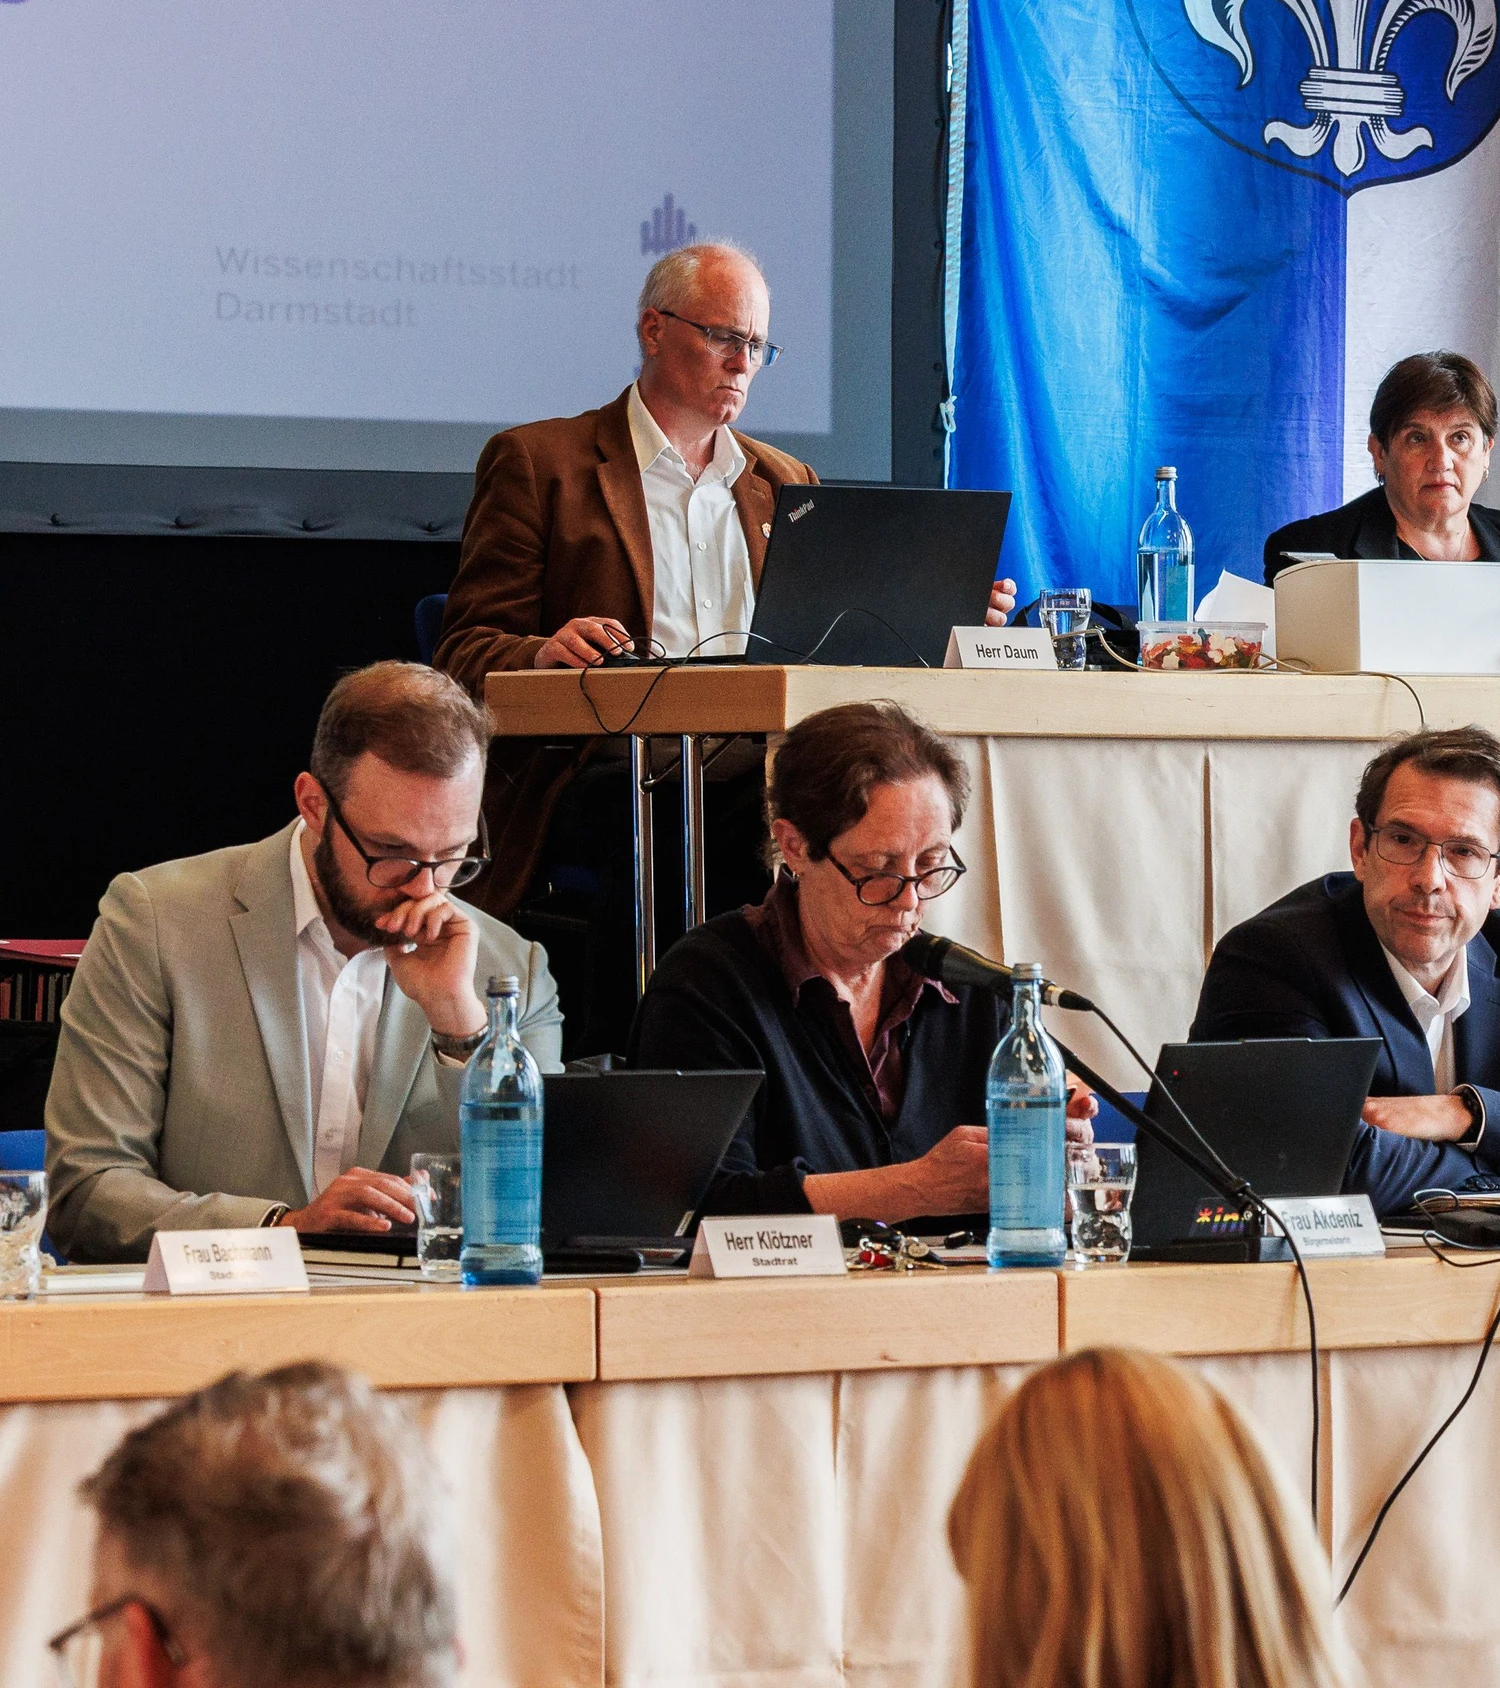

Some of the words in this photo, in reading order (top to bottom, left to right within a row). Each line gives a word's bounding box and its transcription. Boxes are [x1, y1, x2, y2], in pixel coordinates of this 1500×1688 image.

[215, 246, 581, 290] Wissenschaftsstadt
[215, 291, 417, 328] Darmstadt
[788, 499, 815, 522] ThinkPad
[975, 643, 1001, 658] Herr
[1003, 644, 1039, 660] Daum
[1281, 1211, 1311, 1231] Frau
[1312, 1208, 1364, 1231] Akdeniz
[724, 1231, 754, 1251] Herr
[756, 1230, 813, 1250] Klötzner
[183, 1243, 211, 1264] Frau
[752, 1257, 798, 1267] Stadtrat
